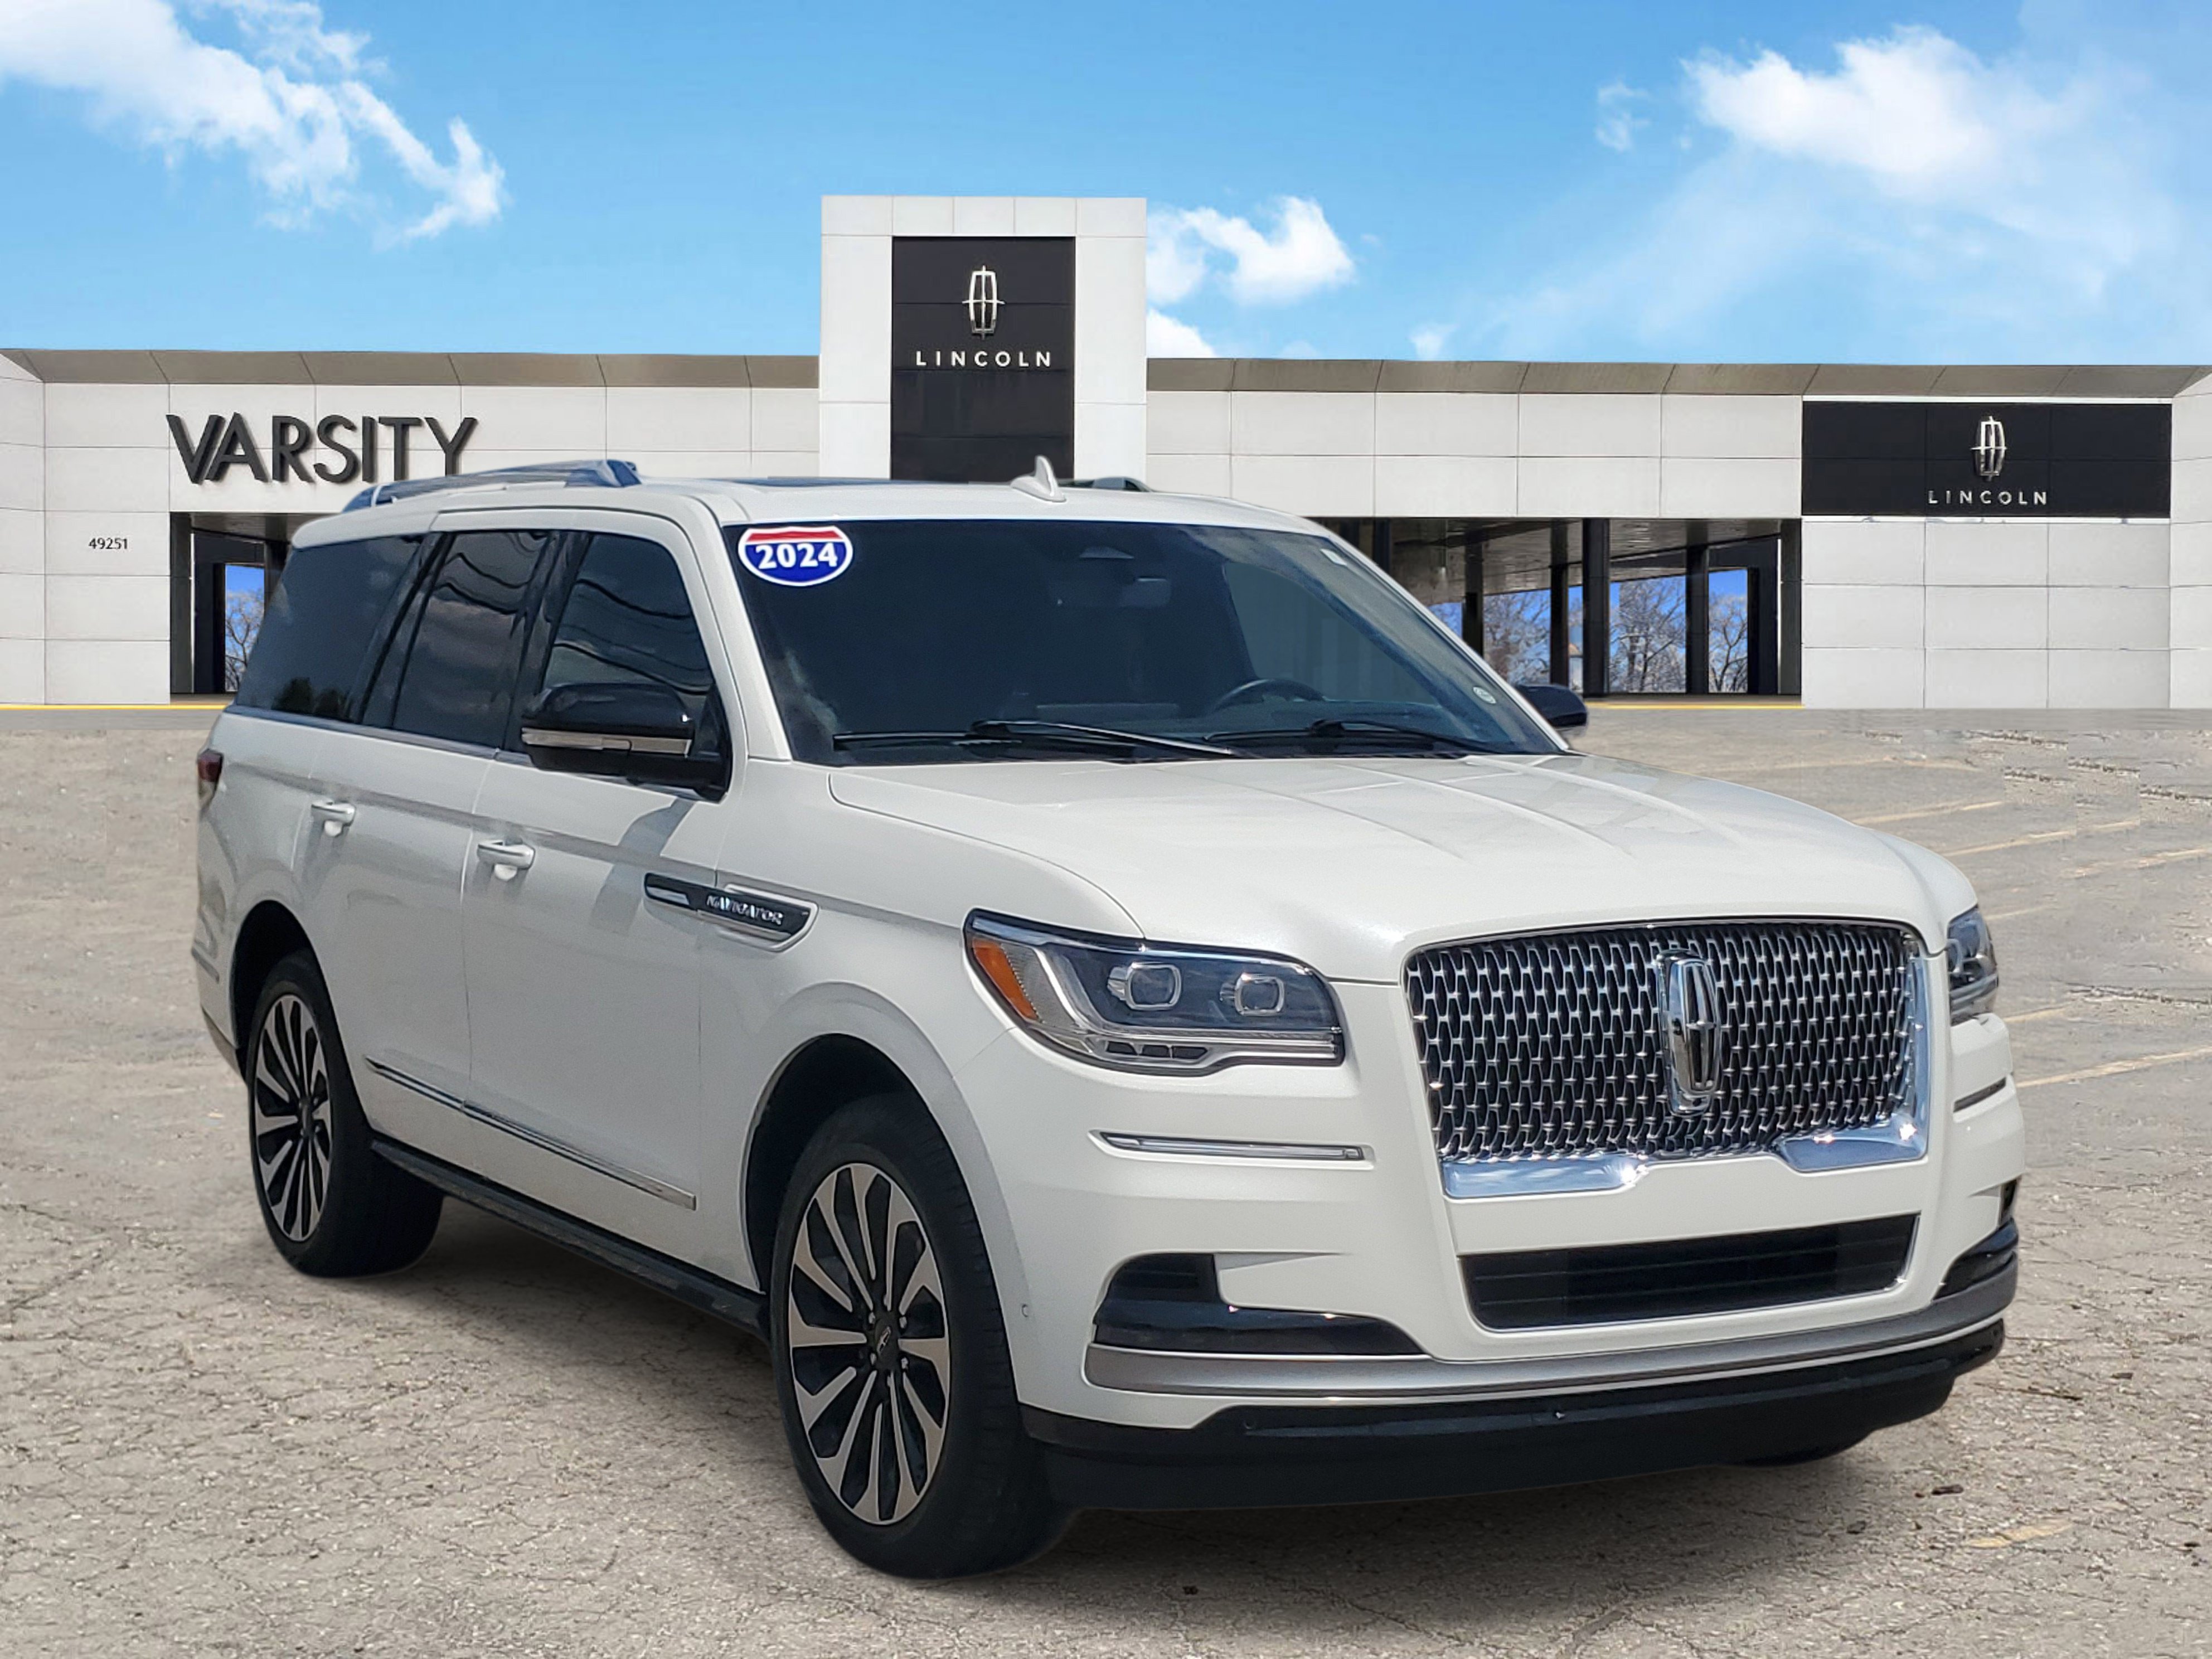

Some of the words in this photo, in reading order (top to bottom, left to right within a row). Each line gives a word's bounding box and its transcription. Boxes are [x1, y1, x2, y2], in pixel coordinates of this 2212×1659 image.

[916, 351, 1051, 367] LINCOLN
[166, 413, 478, 484] VARSITY
[1928, 490, 2047, 505] LINCOLN
[88, 537, 128, 550] 49251
[755, 542, 838, 569] 2024
[706, 895, 783, 925] NAVIGATOR
